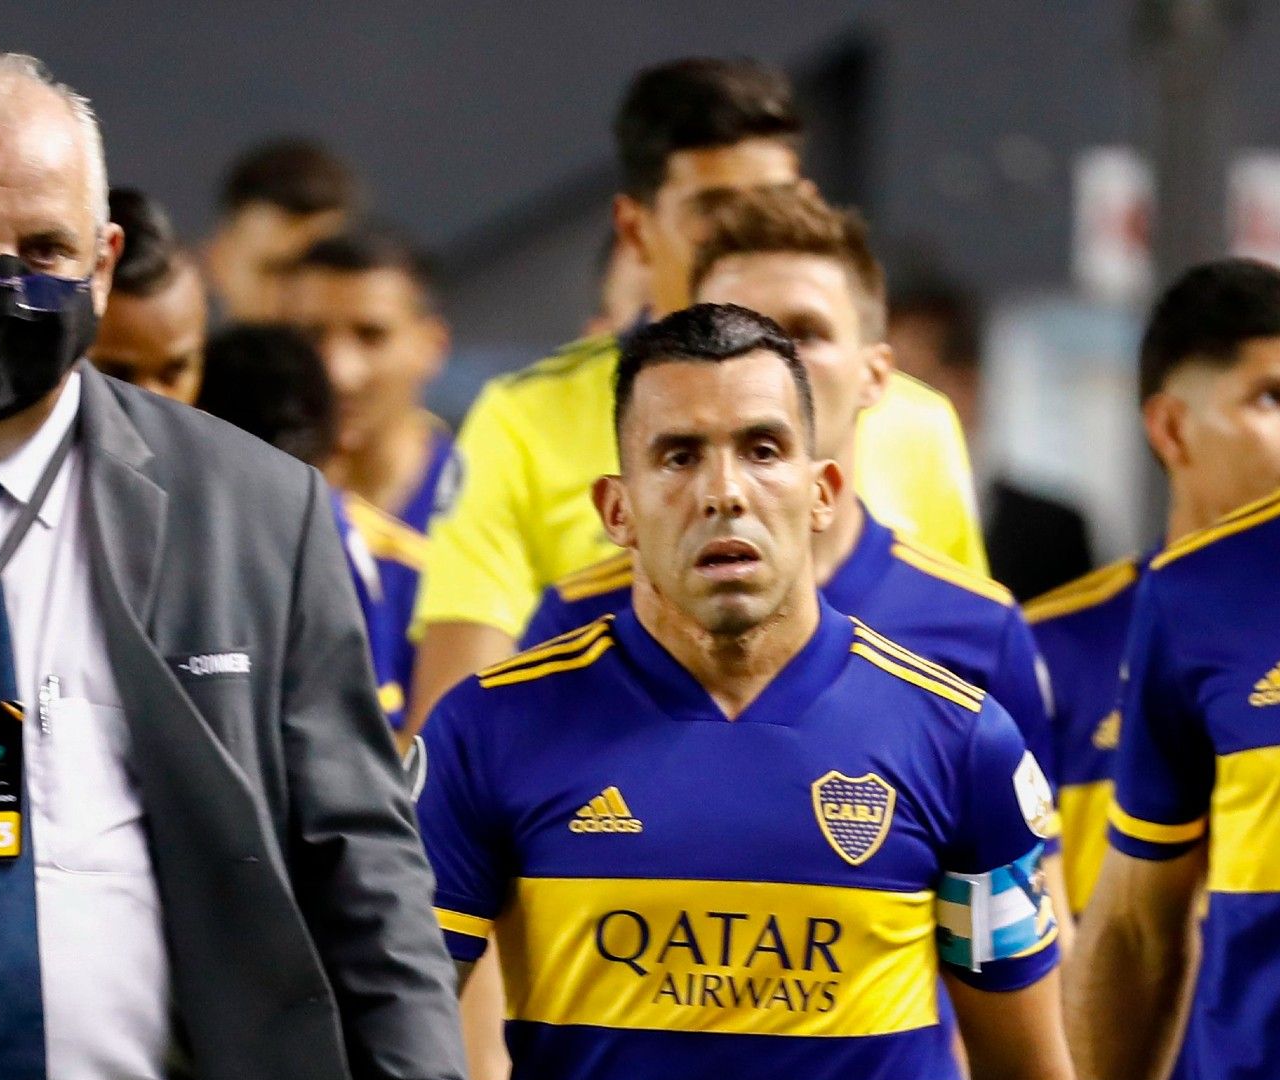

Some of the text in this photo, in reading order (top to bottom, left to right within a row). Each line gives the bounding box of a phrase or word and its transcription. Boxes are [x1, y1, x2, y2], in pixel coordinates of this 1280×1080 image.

[568, 818, 643, 833] adidas
[822, 802, 885, 823] CABJ
[595, 909, 842, 977] QATAR
[651, 972, 840, 1013] AIRWAYS
